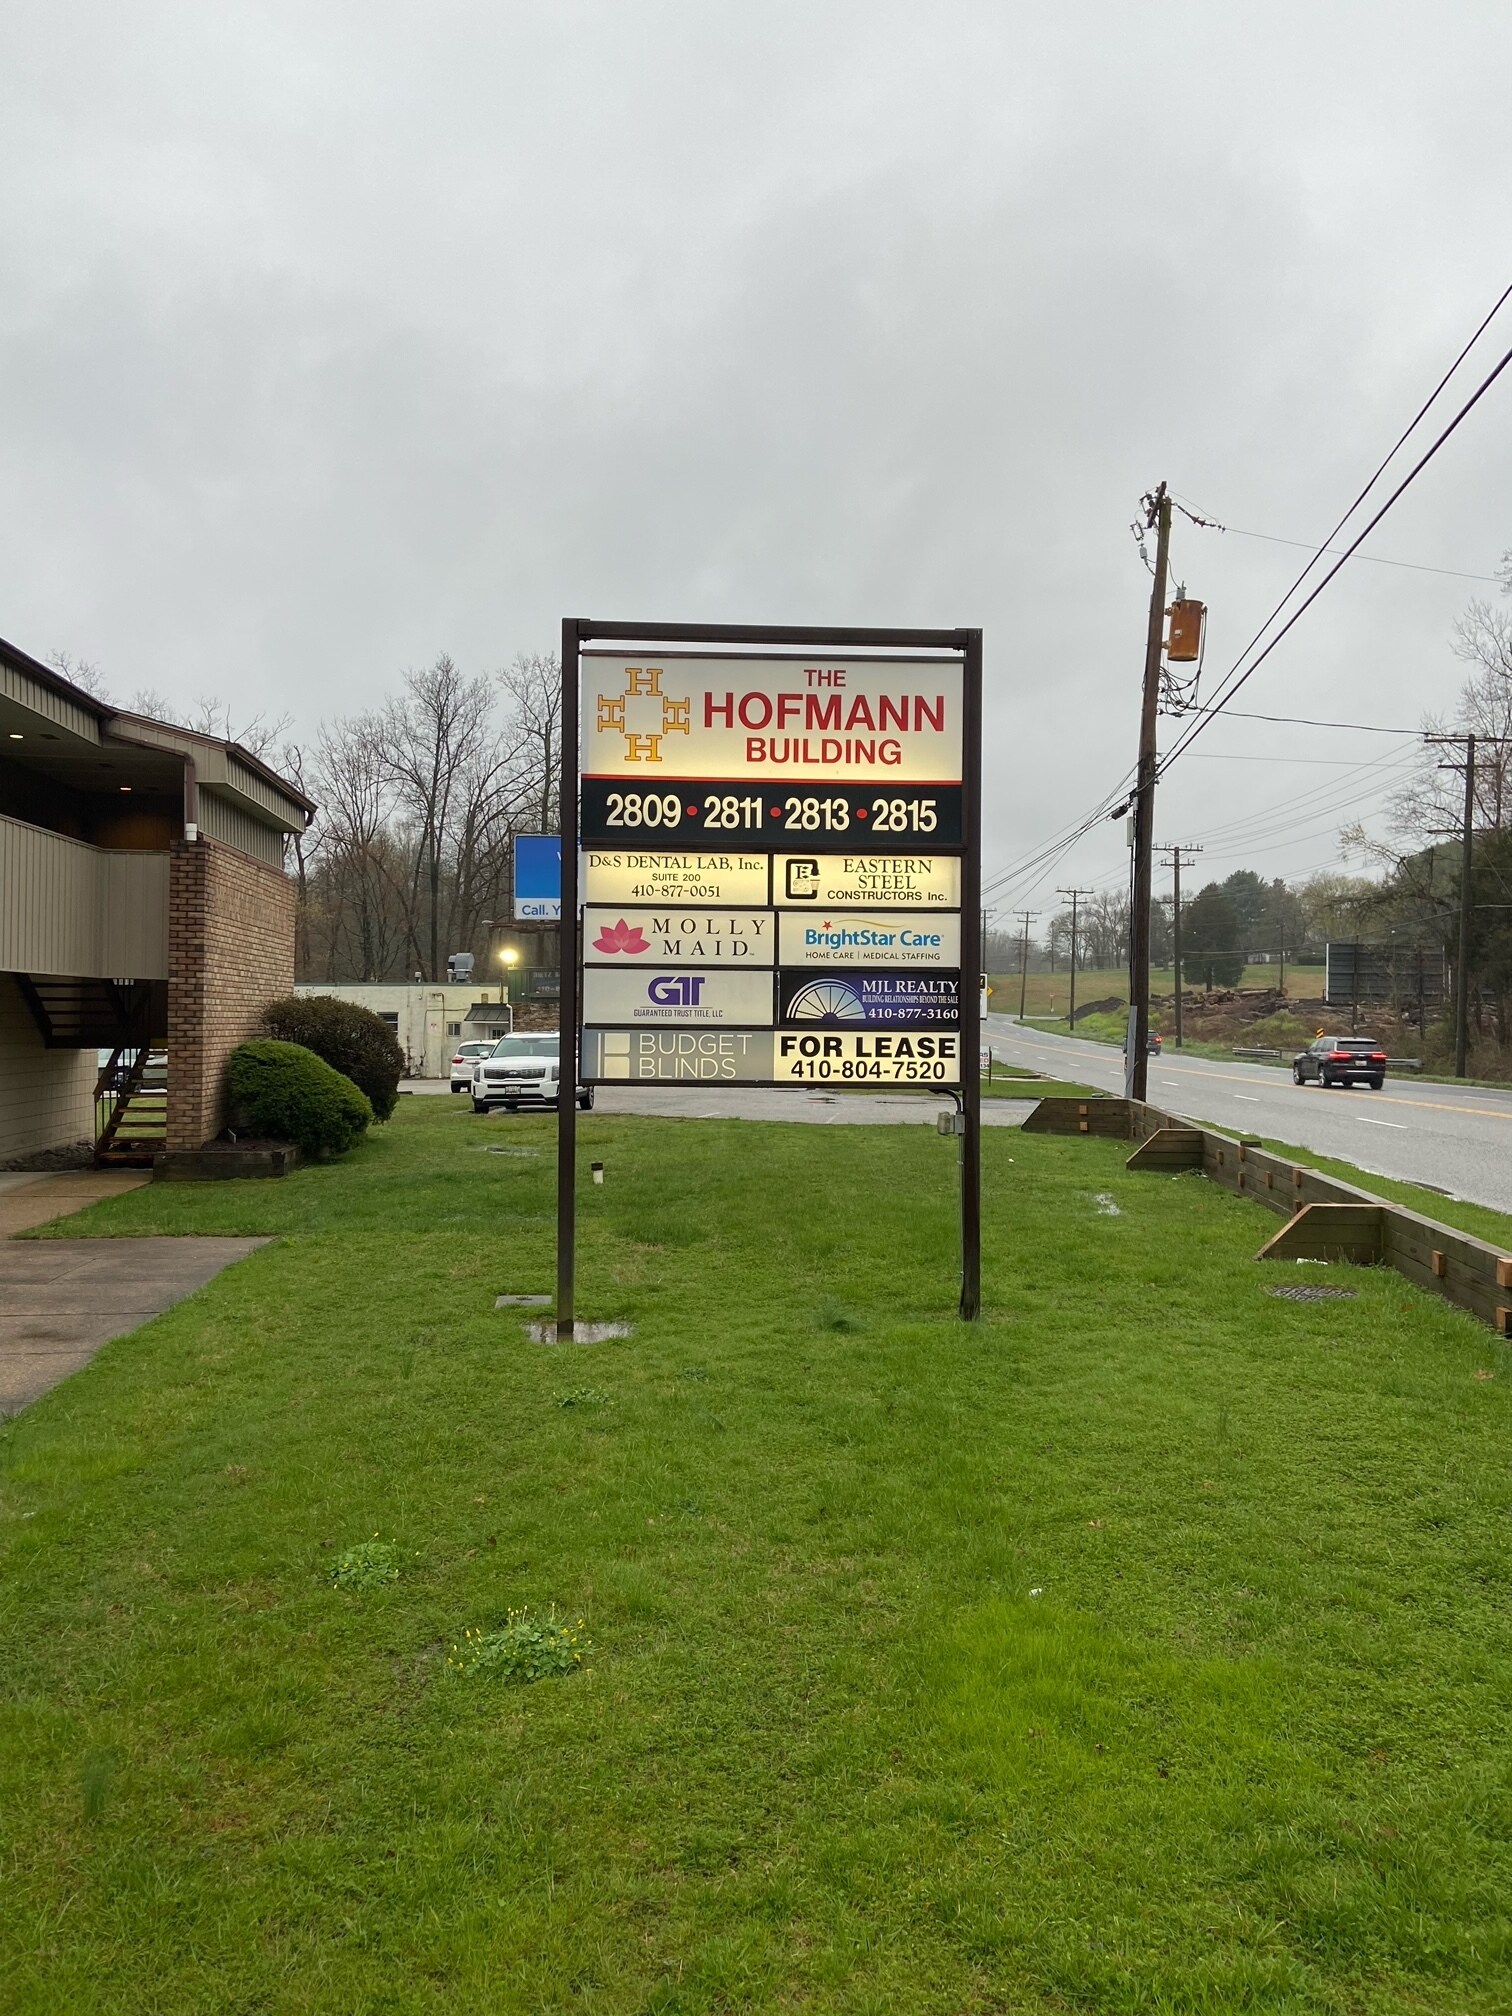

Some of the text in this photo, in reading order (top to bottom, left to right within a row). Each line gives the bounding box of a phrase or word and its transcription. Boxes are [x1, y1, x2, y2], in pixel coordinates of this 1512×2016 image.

[804, 669, 846, 687] THE
[704, 691, 944, 732] HOFMANN
[746, 737, 902, 765] BUILDING
[606, 793, 937, 832] 2809 2811 2813 2815
[589, 854, 764, 871] D&S DENTAL LAB, Inc.
[843, 858, 933, 874] EASTERN
[652, 873, 701, 882] SUITE 200
[858, 875, 917, 890] STEEL
[631, 884, 721, 898] 410-877-0051
[827, 890, 948, 901] CONSTRUCTORS Inc.
[522, 904, 549, 916] Call.
[652, 918, 766, 936] MOLLY
[662, 939, 749, 956] MAID
[805, 928, 941, 950] BrightStar Care
[805, 951, 940, 960] HOME CARE MEDICAL STAFFING
[862, 980, 959, 995] MJL REALTY
[938, 995, 947, 1004] THE
[947, 996, 959, 1004] SALE
[633, 1009, 673, 1017] GUARANTEED
[674, 1009, 693, 1018] TRUST
[712, 1010, 723, 1018] LLC
[868, 1008, 959, 1020] 410-877-3160
[639, 1033, 753, 1055] BUDGET
[780, 1035, 956, 1059] FOR LEASE
[639, 1057, 736, 1079] BLINDS
[791, 1060, 946, 1080] 410-804-7520
